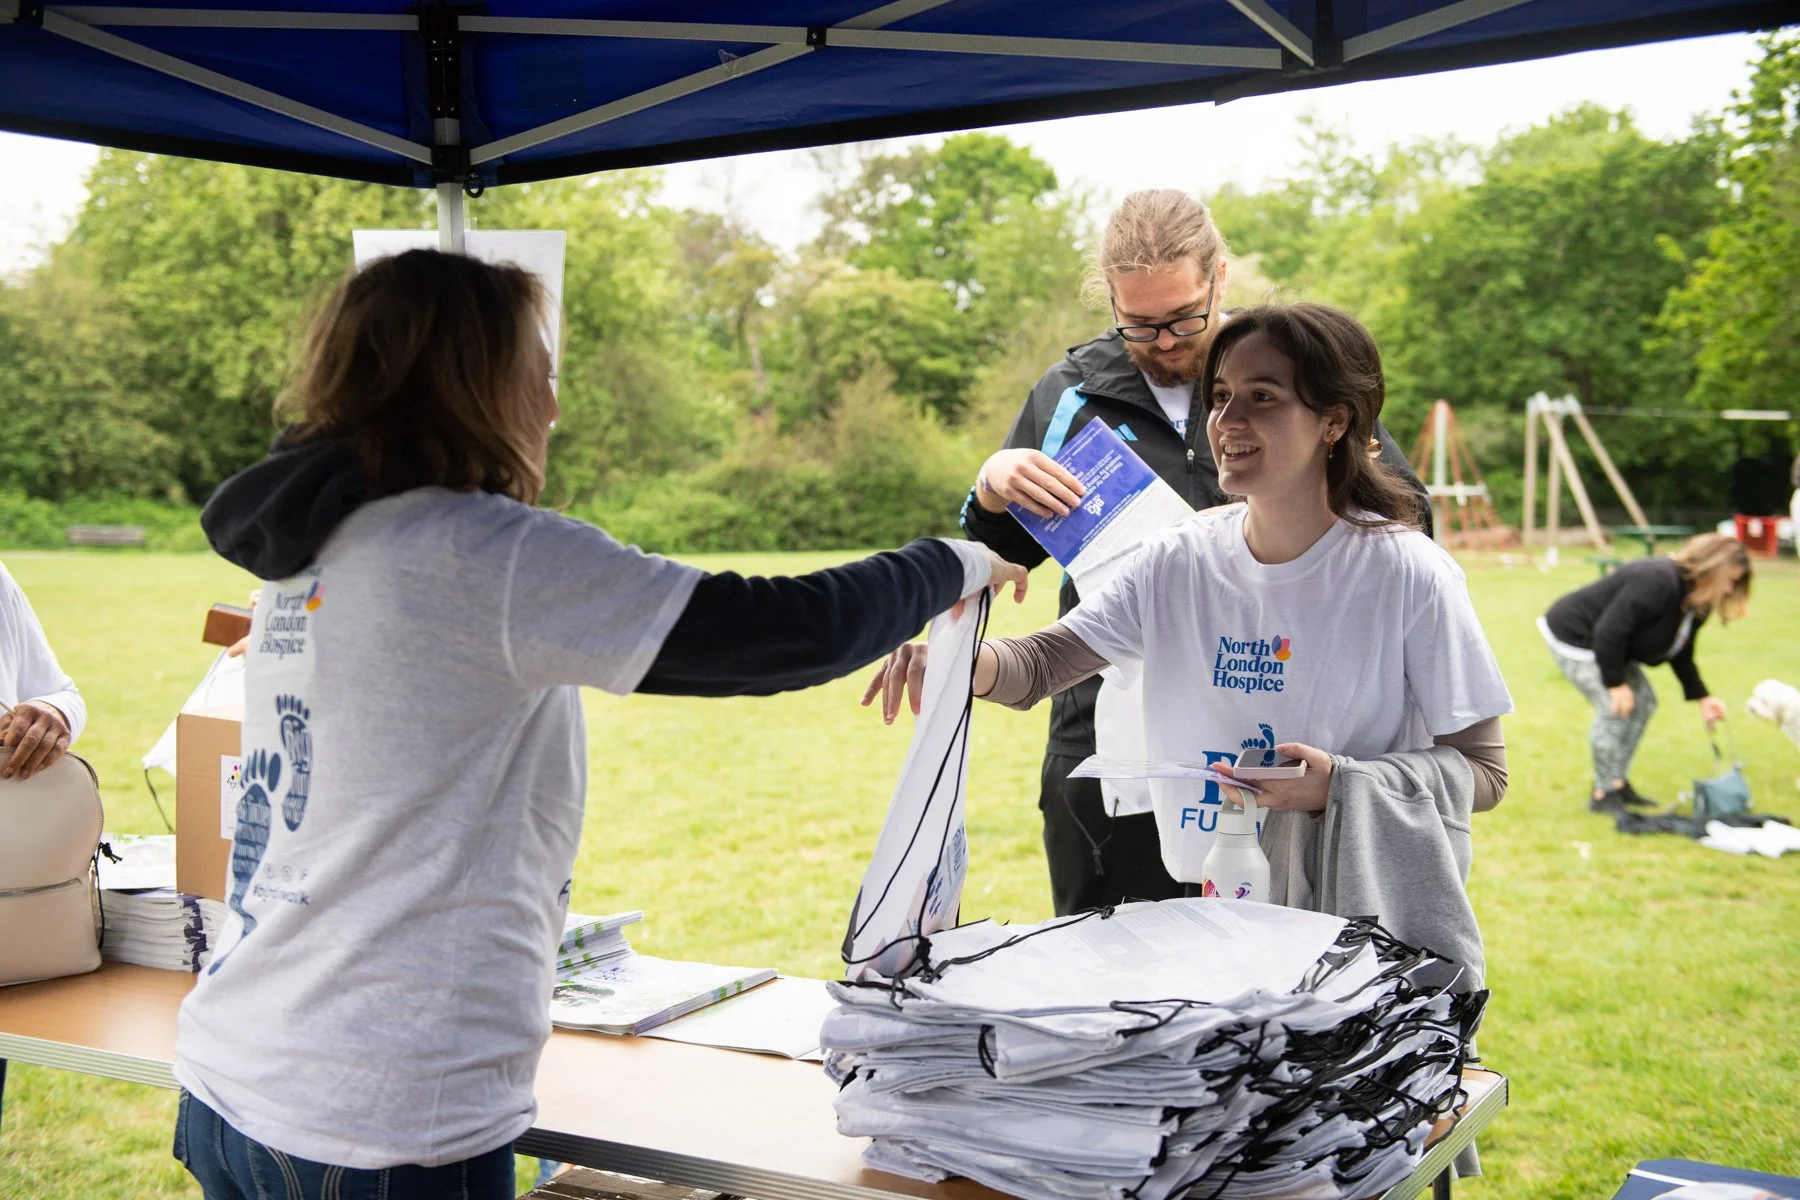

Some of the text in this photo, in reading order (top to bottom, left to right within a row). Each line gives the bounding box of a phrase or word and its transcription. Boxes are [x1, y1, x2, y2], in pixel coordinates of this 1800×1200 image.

[1218, 636, 1270, 656] North
[1214, 653, 1284, 675] London
[1212, 670, 1284, 694] Hospice
[1180, 807, 1220, 833] FU
